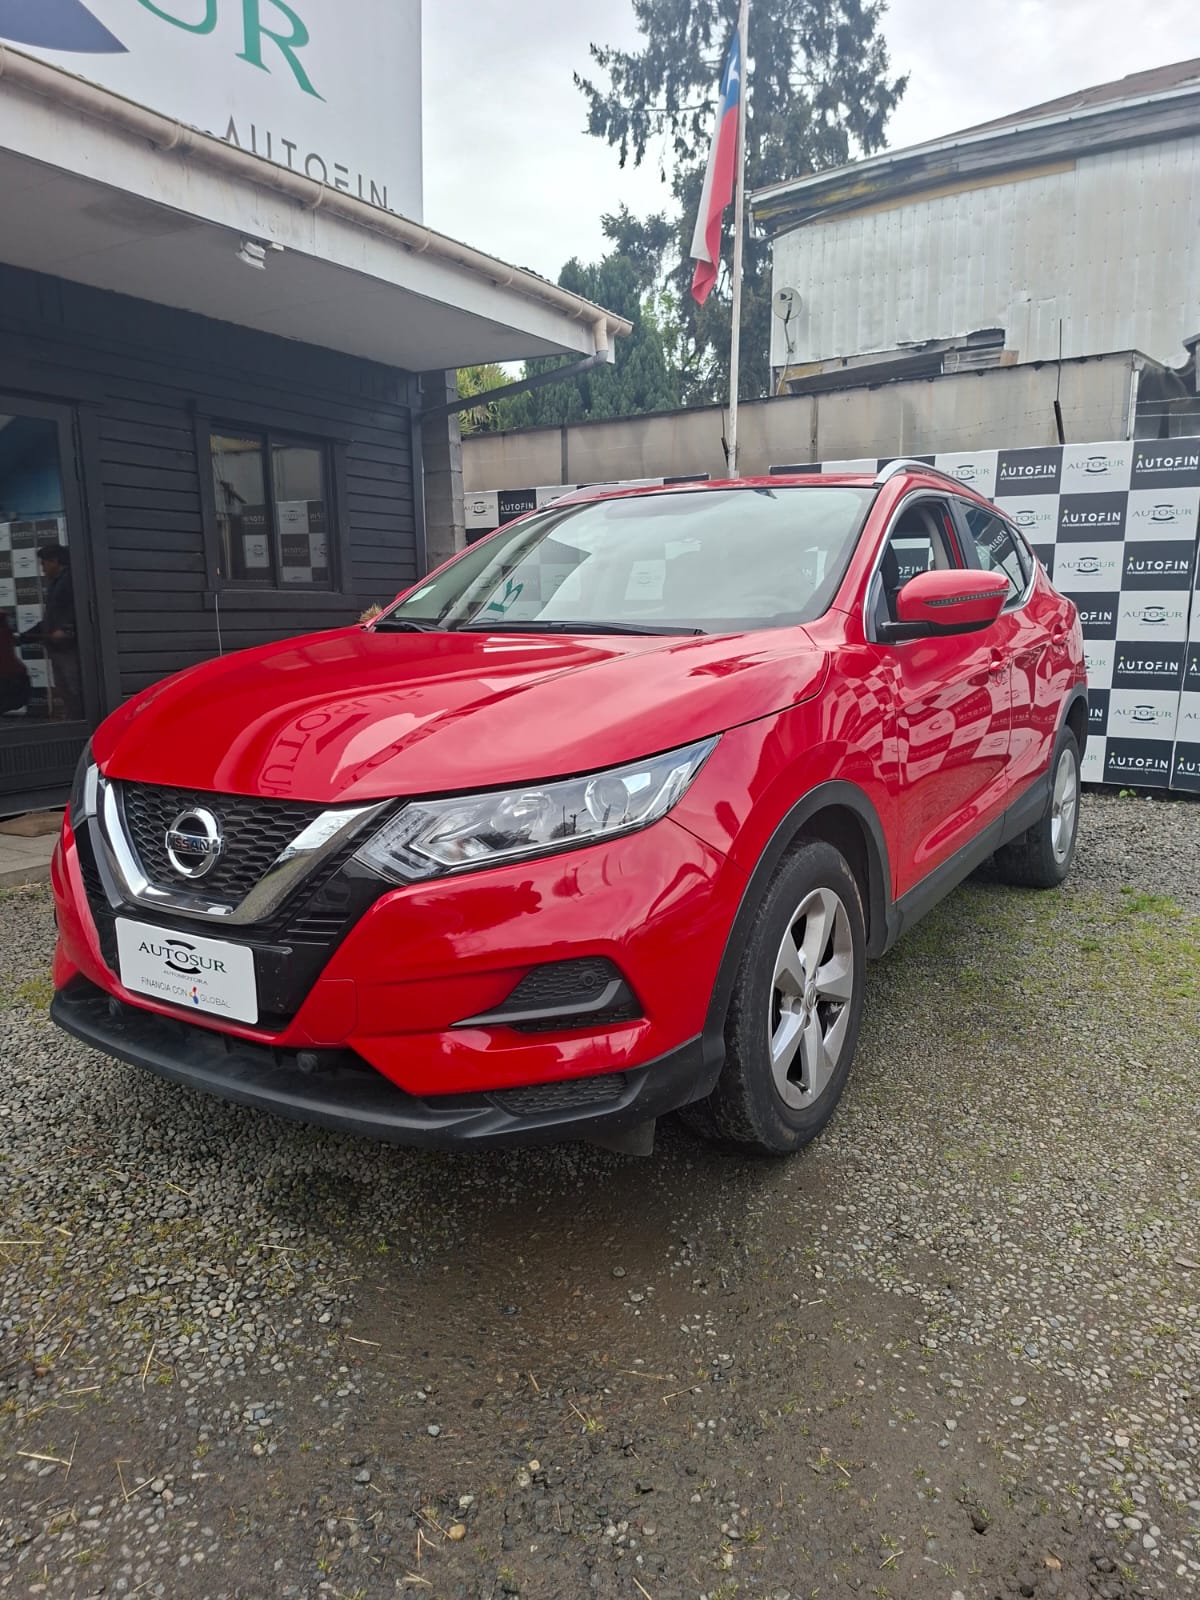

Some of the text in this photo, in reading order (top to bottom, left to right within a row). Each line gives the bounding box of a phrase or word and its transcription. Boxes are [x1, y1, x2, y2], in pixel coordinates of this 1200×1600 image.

[1066, 459, 1125, 470] AUTOSUR
[1136, 454, 1199, 469] AUTOFIN
[1000, 463, 1057, 477] AUTOFIN
[500, 501, 534, 512] AUTOFIN
[1131, 509, 1193, 518] AUTOSUR
[1061, 509, 1121, 523] AUTOFIN
[1058, 561, 1116, 569] AUTOSUR
[1126, 556, 1189, 570] AUTOFIN
[1123, 610, 1183, 618] AUTOSUR
[1117, 656, 1179, 671] AUTOFIN
[1113, 708, 1172, 718] AUTOSUR
[1108, 752, 1169, 769] AUTOFIN
[138, 941, 228, 974] AUTOSUR
[140, 976, 232, 1009] FINANCIA CON GLOBAL
